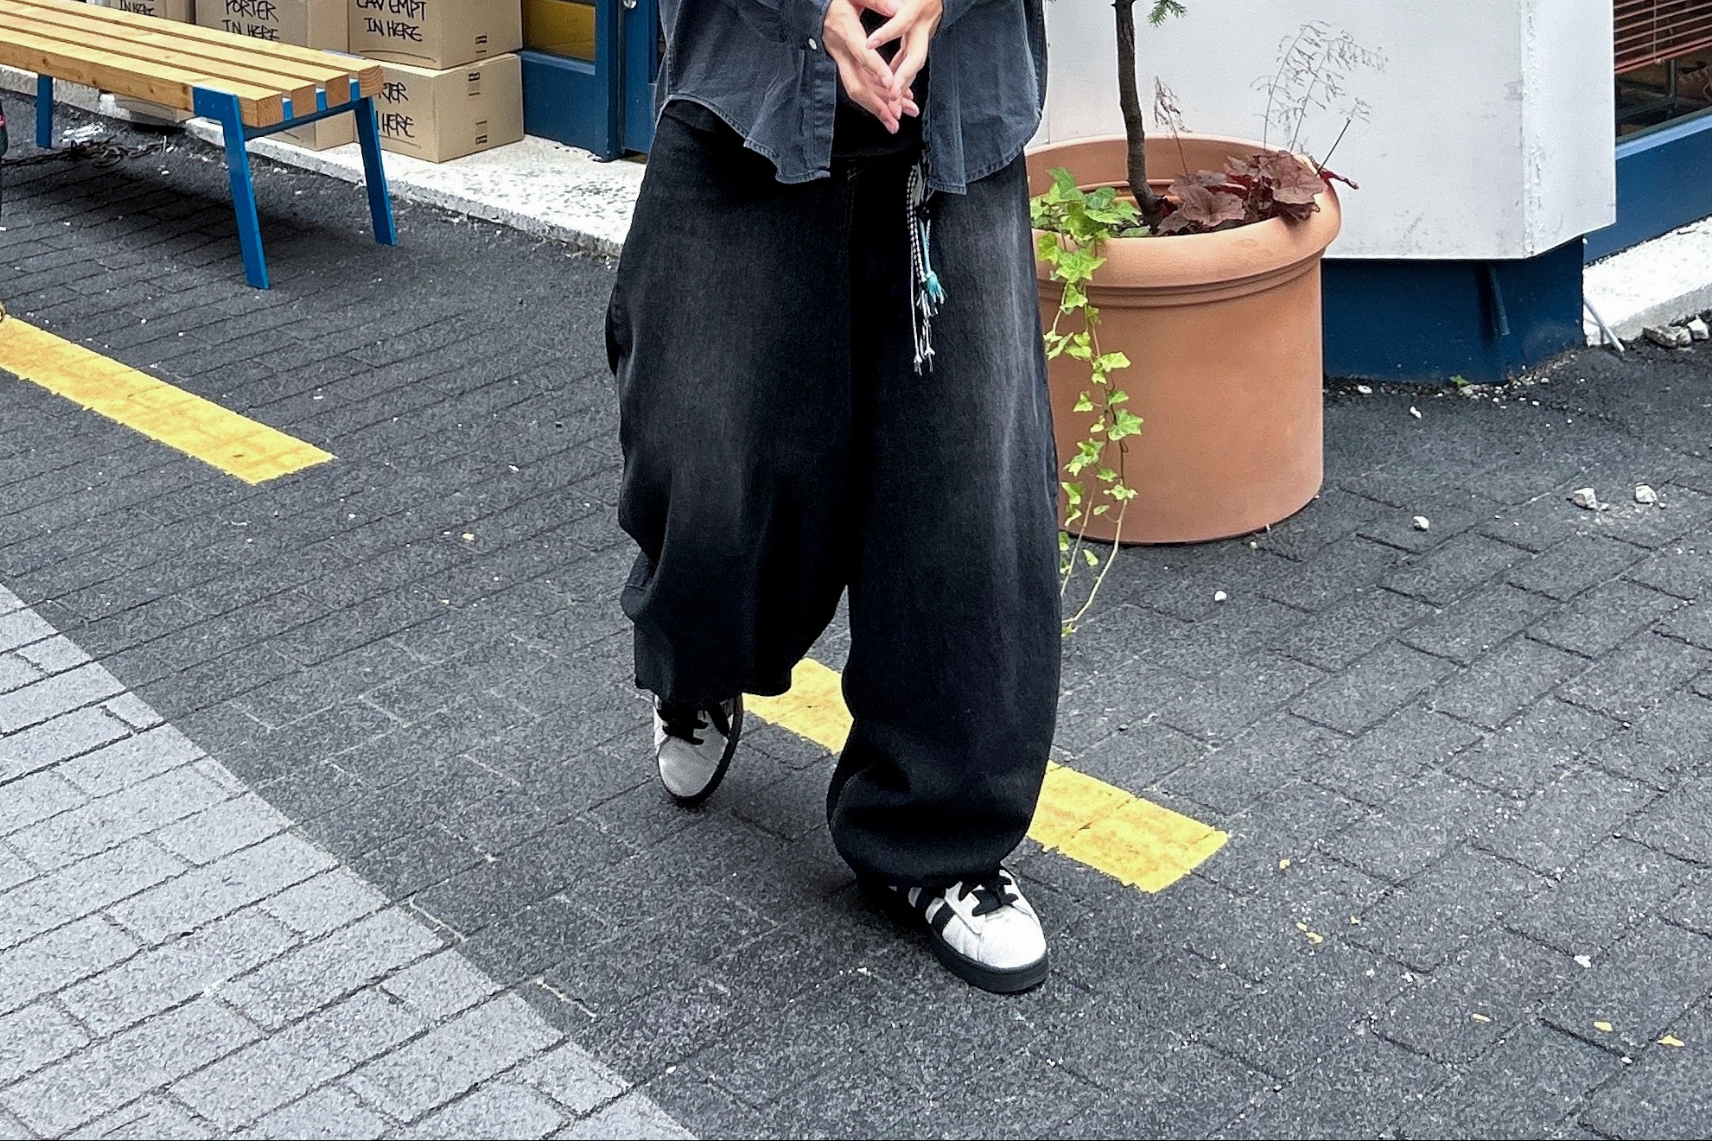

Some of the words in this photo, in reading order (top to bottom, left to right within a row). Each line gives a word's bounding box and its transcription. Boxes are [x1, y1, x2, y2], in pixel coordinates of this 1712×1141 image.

[222, 19, 242, 36] IN
[247, 23, 280, 41] HERE
[364, 17, 384, 36] IN
[387, 20, 422, 42] HERE
[382, 112, 415, 138] HERE
